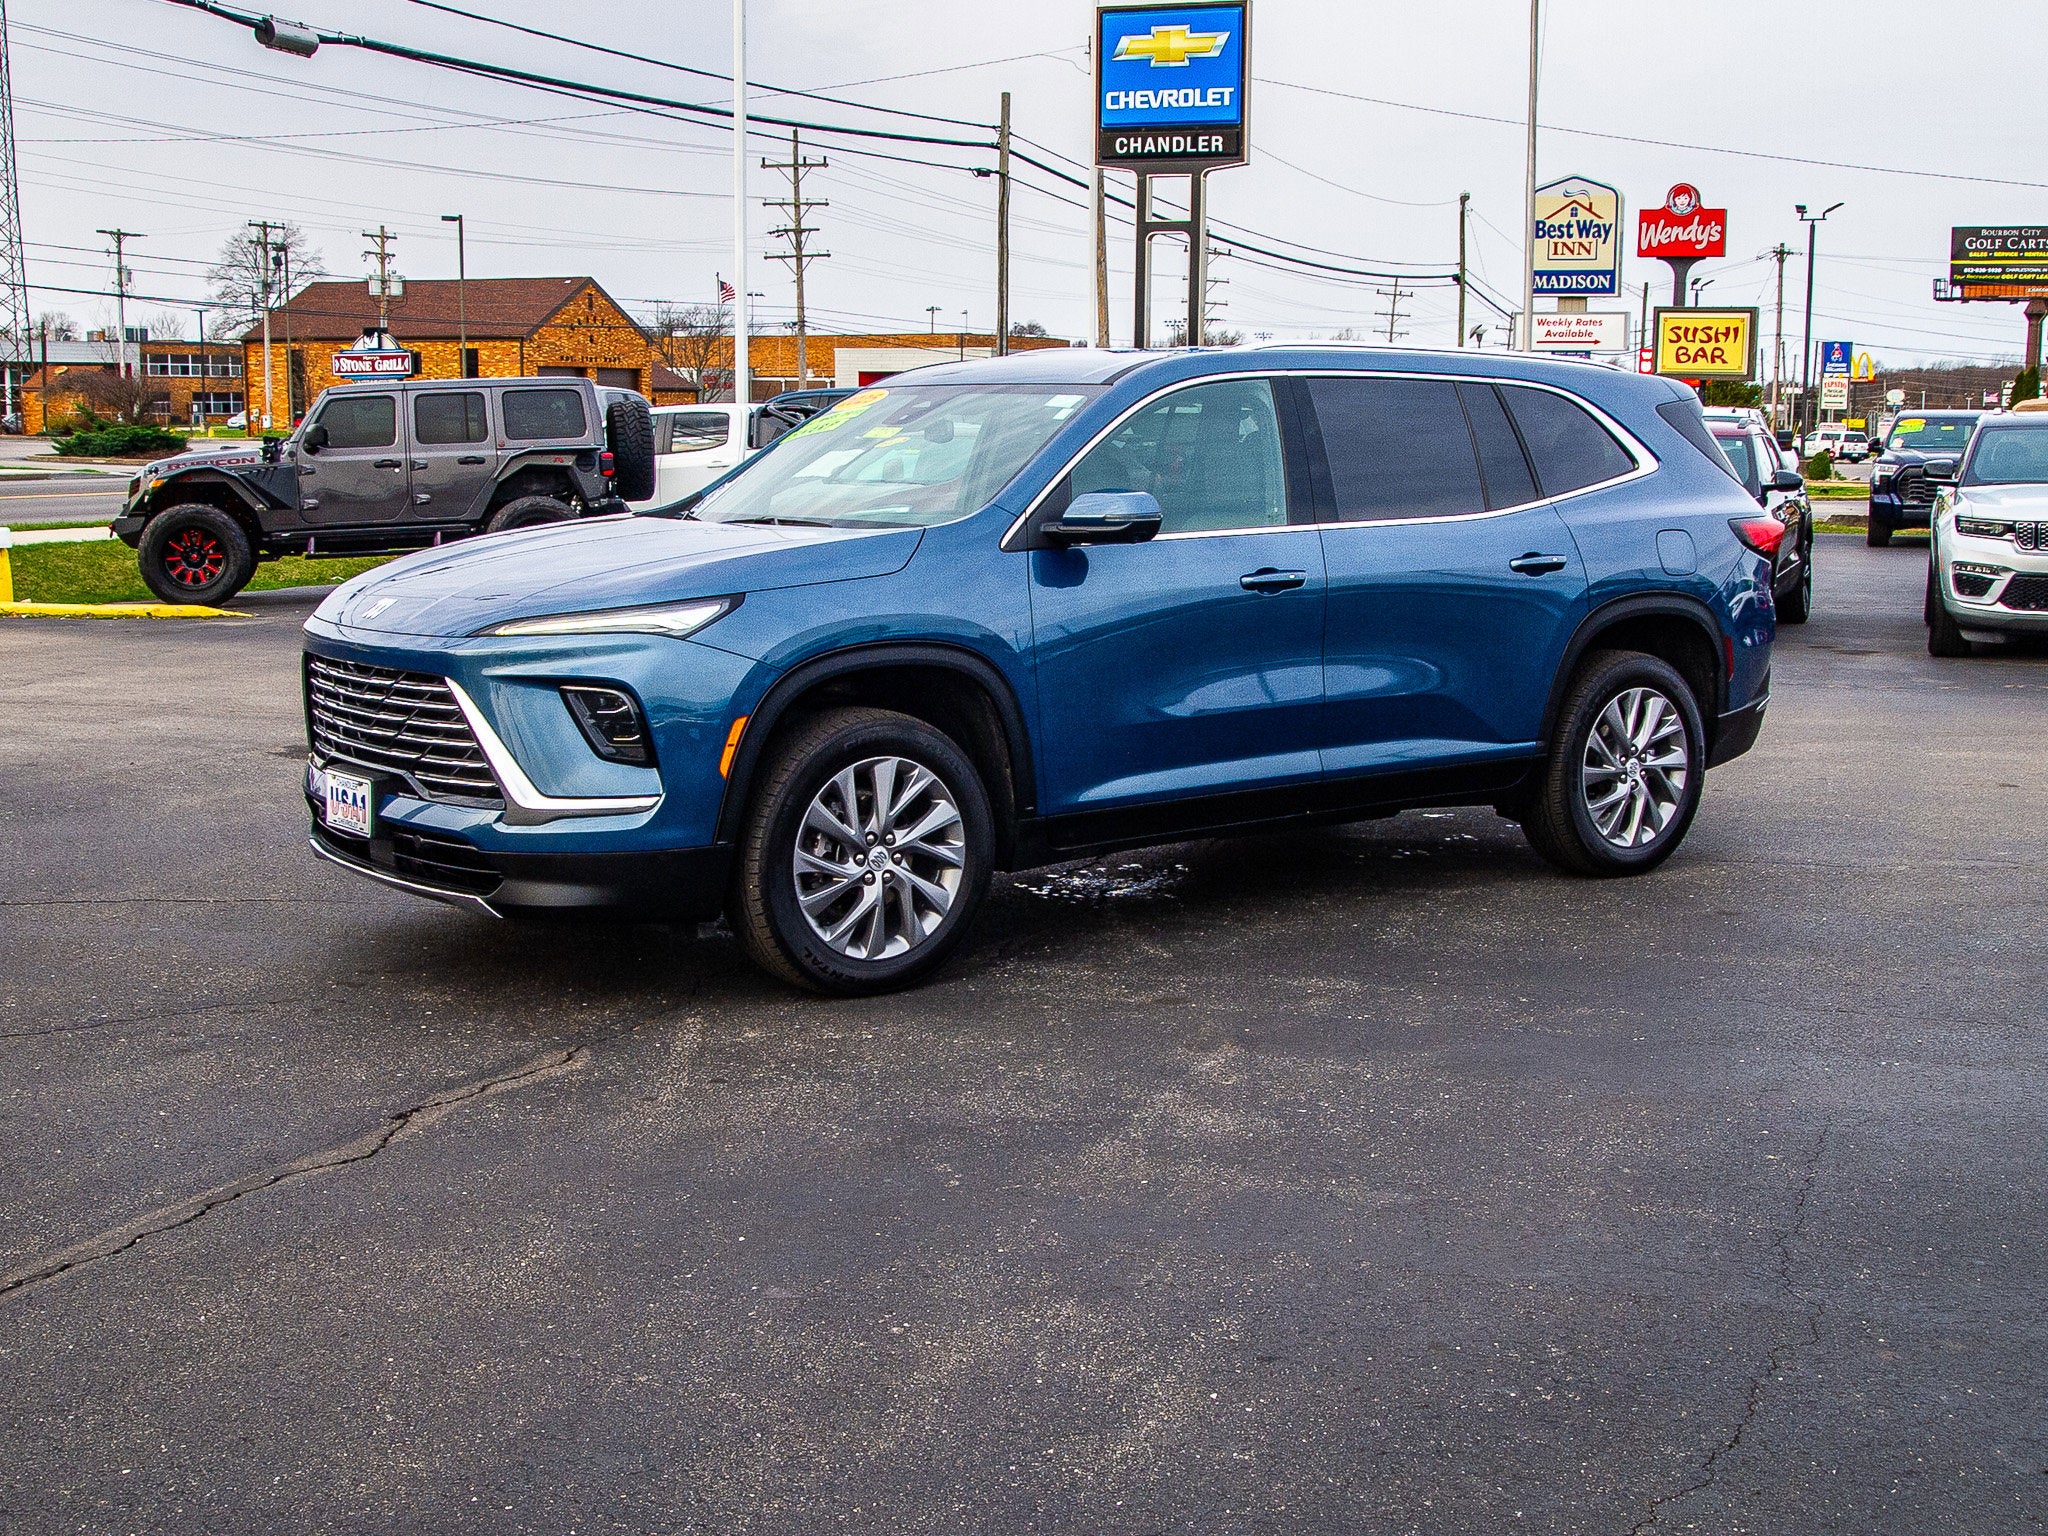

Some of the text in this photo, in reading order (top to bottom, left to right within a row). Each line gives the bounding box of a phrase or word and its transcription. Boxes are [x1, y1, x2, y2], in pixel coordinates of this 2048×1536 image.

[1105, 87, 1235, 110] CHEVROLET
[1114, 135, 1224, 154] CHANDLER
[1534, 219, 1613, 245] Best Way
[1640, 214, 1722, 250] Wendy's
[2021, 228, 2041, 236] CITY
[1551, 241, 1593, 256] INN
[1964, 237, 2003, 249] GOLF
[1532, 274, 1611, 289] MADISON
[1536, 318, 1603, 328] Weekly Rates
[1544, 329, 1593, 338] Available
[1668, 325, 1740, 344] SUSHI
[1675, 346, 1728, 364] BAR
[340, 357, 404, 372] STONE GRILL
[167, 456, 255, 471] RUBICON
